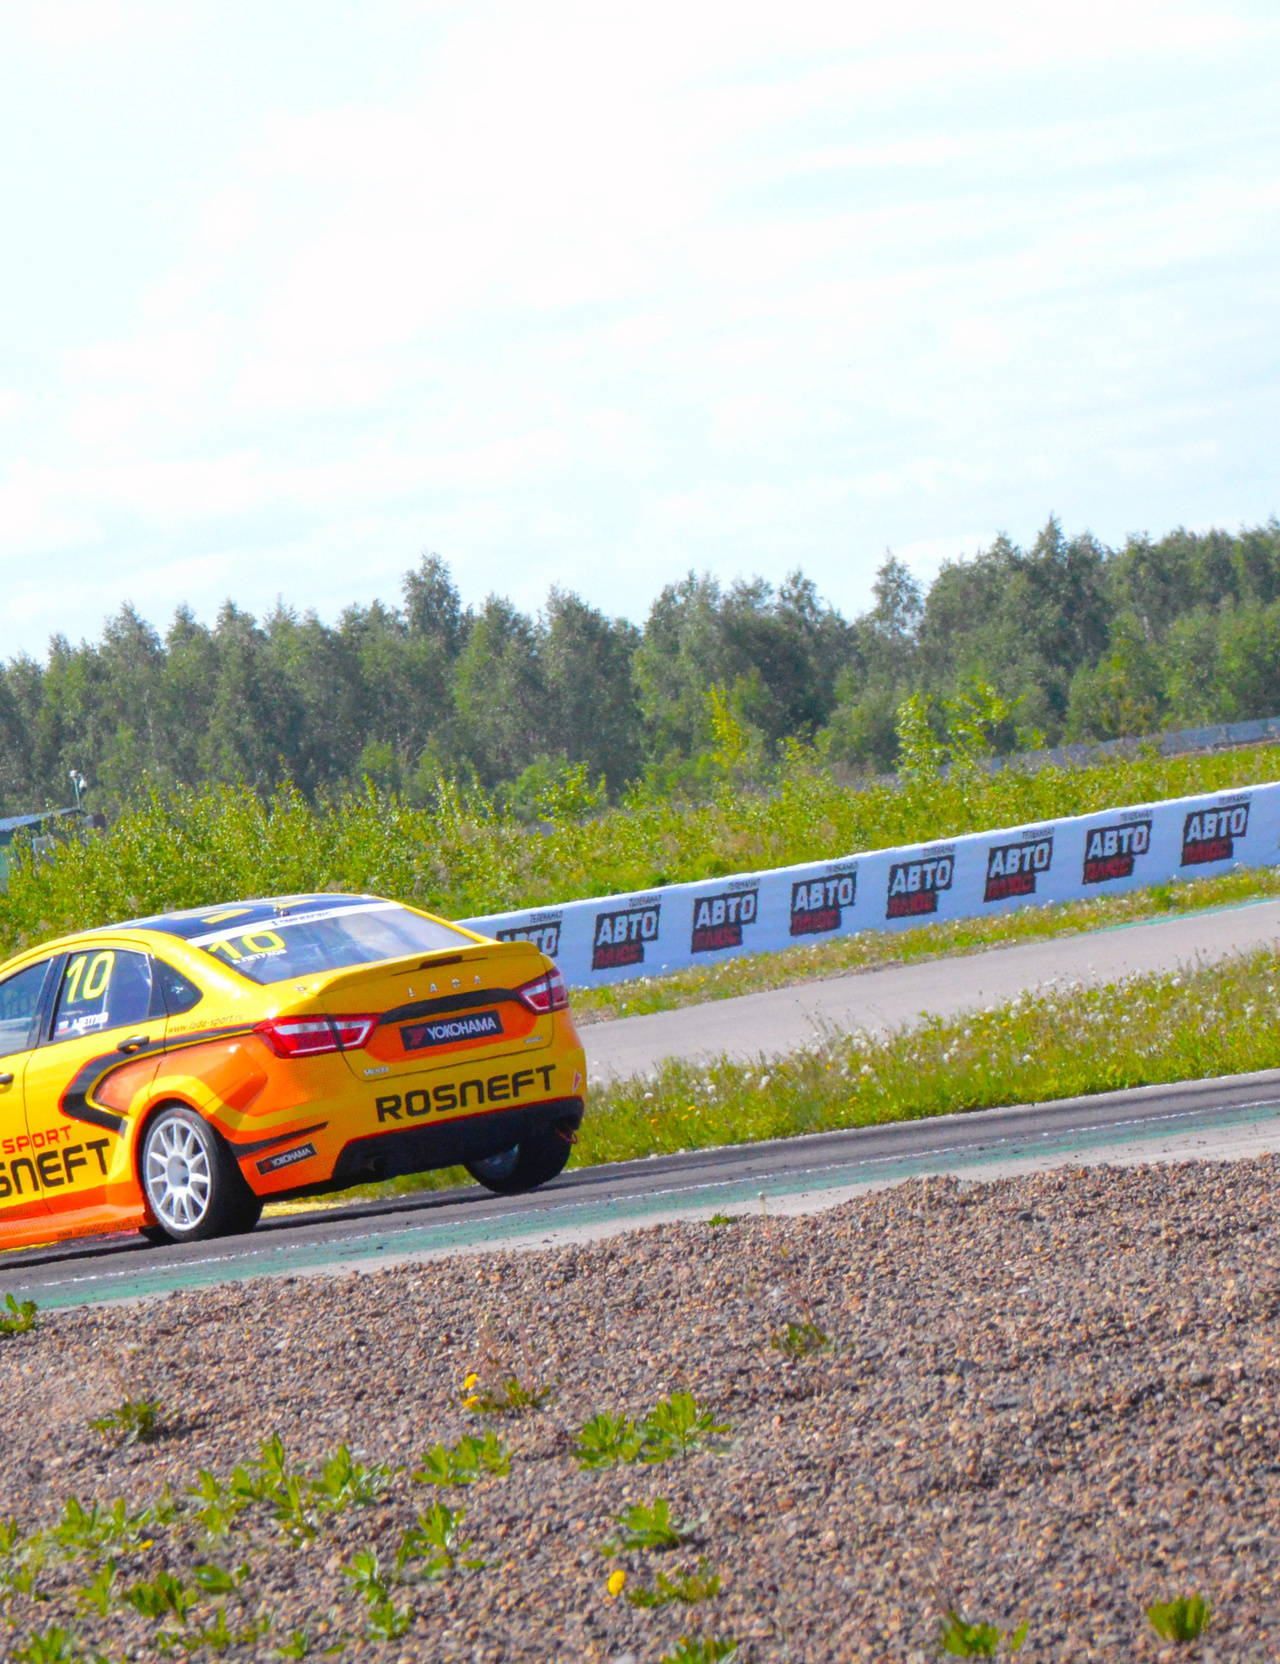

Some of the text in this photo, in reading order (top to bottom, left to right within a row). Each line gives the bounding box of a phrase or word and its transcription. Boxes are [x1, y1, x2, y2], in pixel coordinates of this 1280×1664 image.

[1187, 808, 1246, 842] АВТО
[989, 842, 1049, 877] АВТО
[1087, 825, 1148, 860] АВТО
[794, 878, 853, 911] АВТО
[891, 861, 951, 896] АВТО
[596, 911, 657, 946] АВТО
[696, 894, 754, 929] АВТО
[208, 931, 286, 959] 10
[67, 951, 114, 1003] 10
[408, 975, 482, 997] LADA
[427, 1016, 496, 1040] YOKOHAMA
[375, 1064, 556, 1123] ROSNEFT
[2, 1125, 71, 1154] SPORT
[270, 1147, 312, 1167] YOKOHAMA
